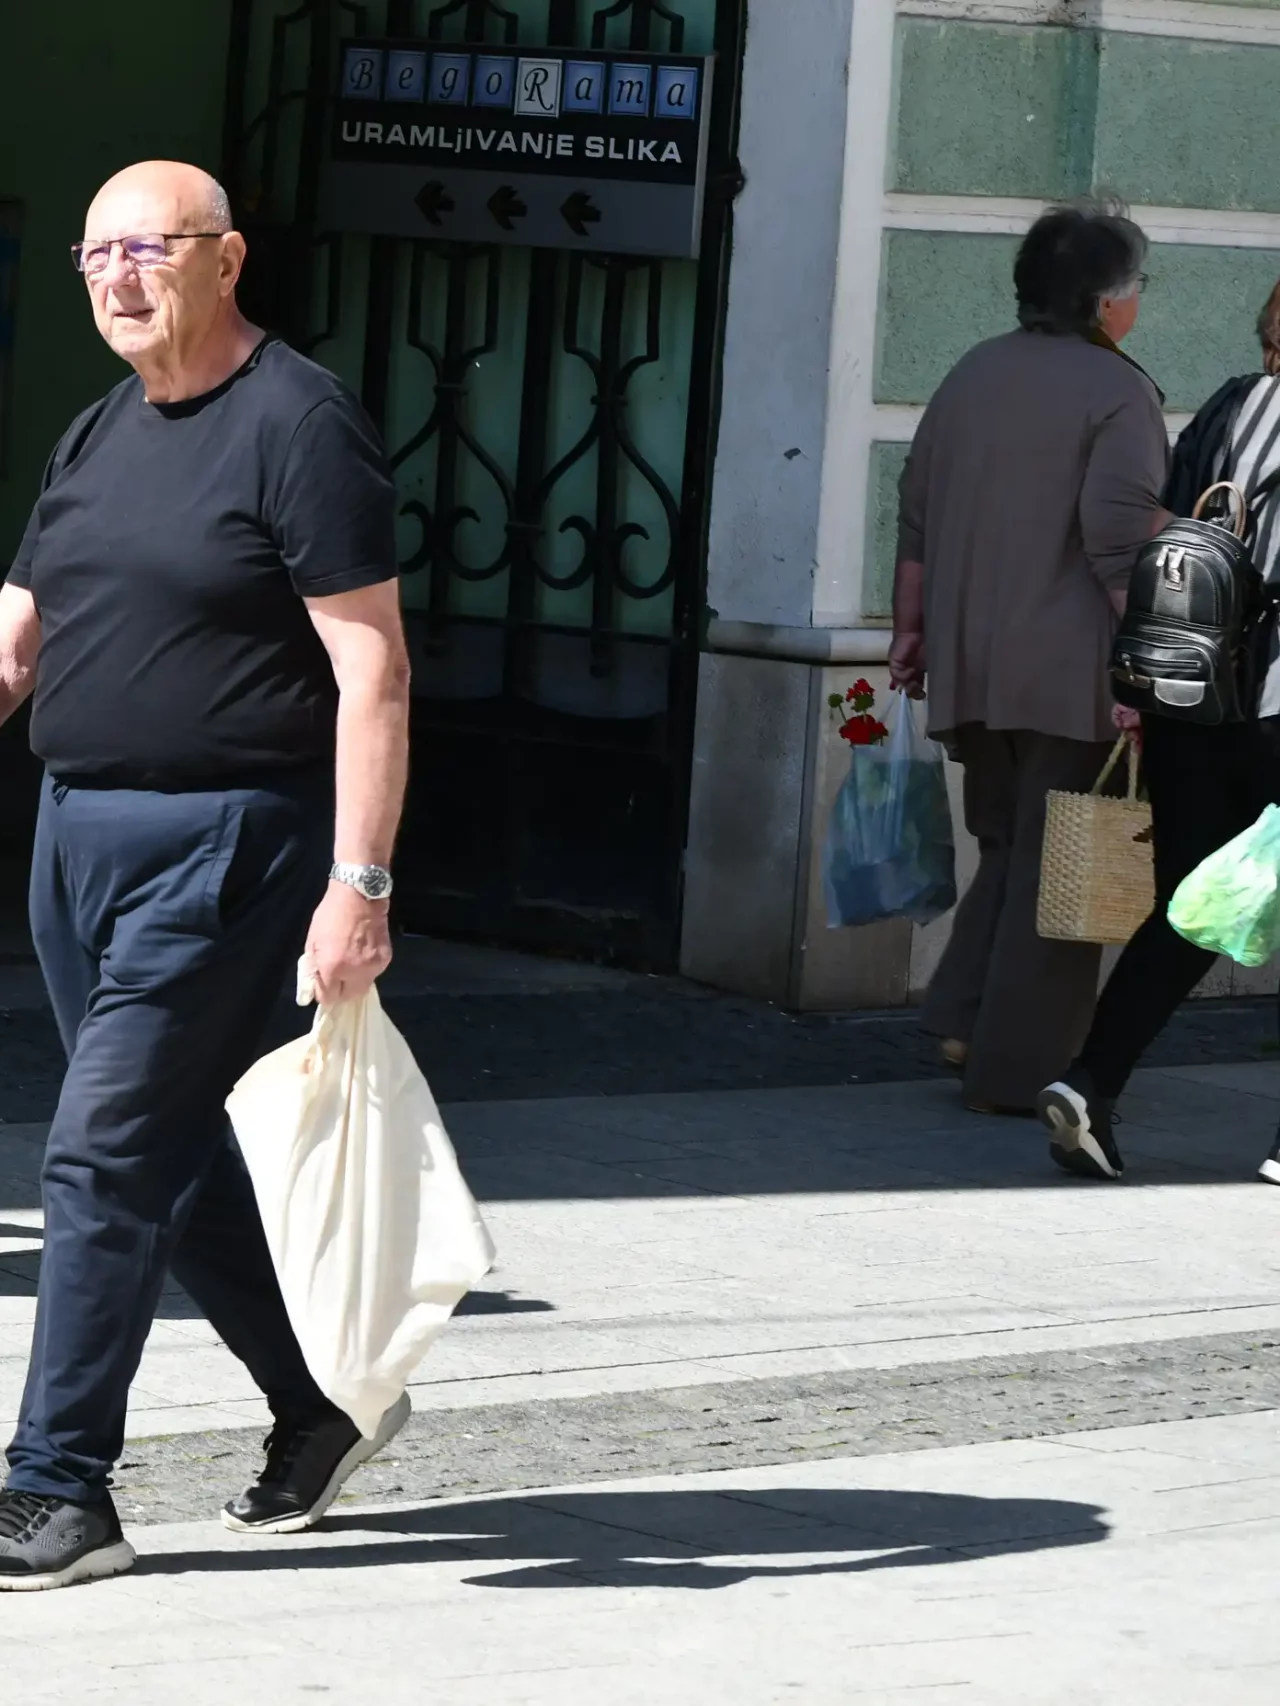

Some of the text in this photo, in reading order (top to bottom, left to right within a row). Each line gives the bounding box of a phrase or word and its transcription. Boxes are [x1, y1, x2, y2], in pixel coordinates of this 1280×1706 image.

[350, 58, 686, 110] BegoRama
[342, 121, 683, 163] URAMLjIVANjE SLIKA
